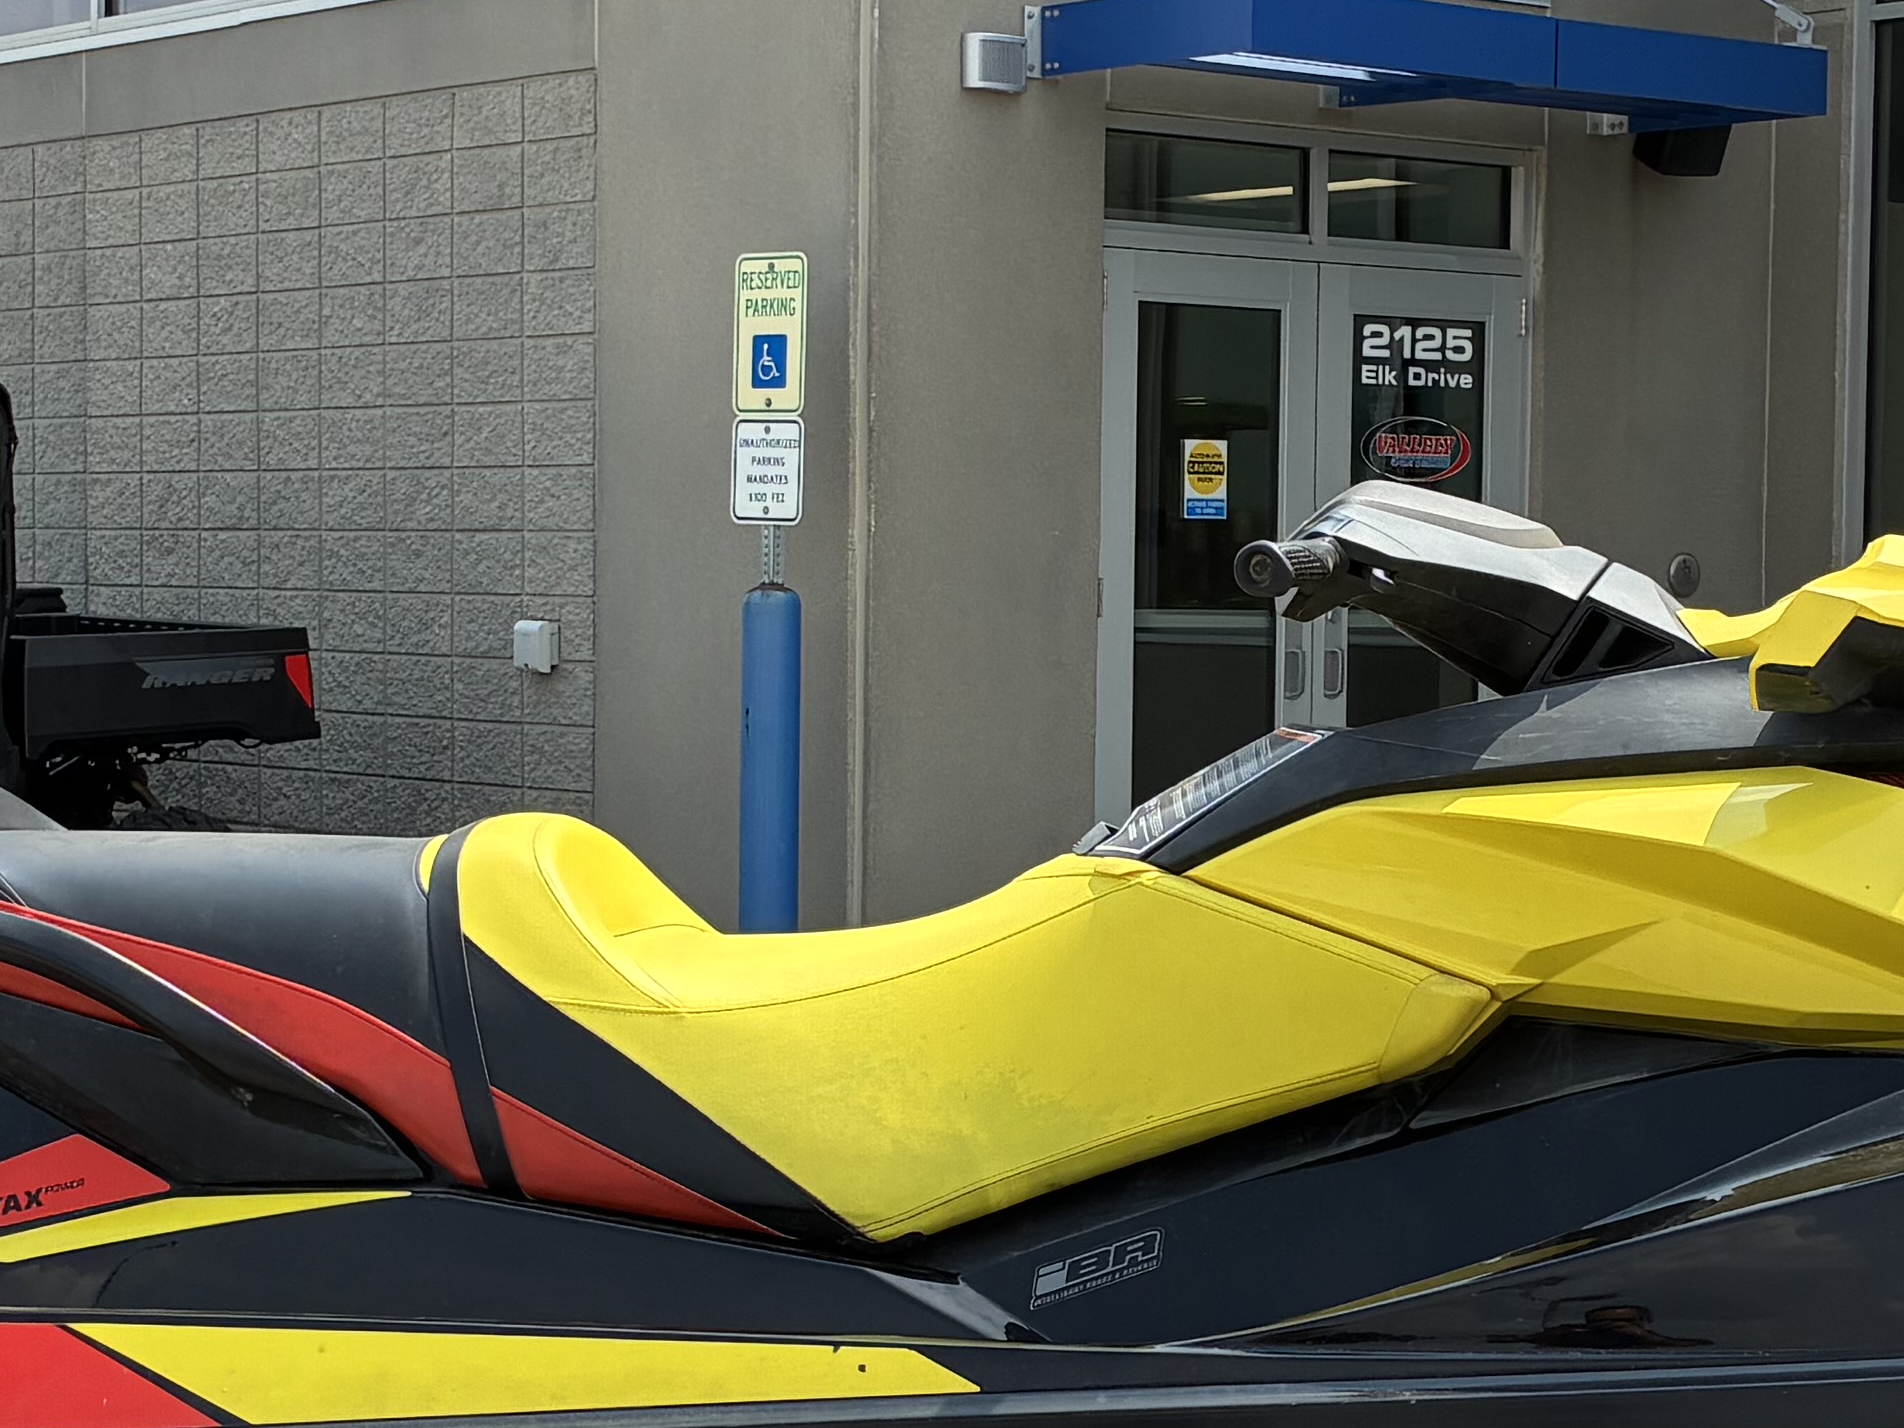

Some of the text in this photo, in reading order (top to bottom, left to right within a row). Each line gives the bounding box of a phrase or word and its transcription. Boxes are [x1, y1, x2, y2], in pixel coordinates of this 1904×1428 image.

[741, 269, 801, 291] RESERVED
[745, 297, 796, 318] PARKING
[1362, 324, 1474, 362] 2125
[1361, 364, 1474, 389] Elk Drive
[141, 668, 276, 690] RANGER
[44, 1177, 86, 1195] POWER
